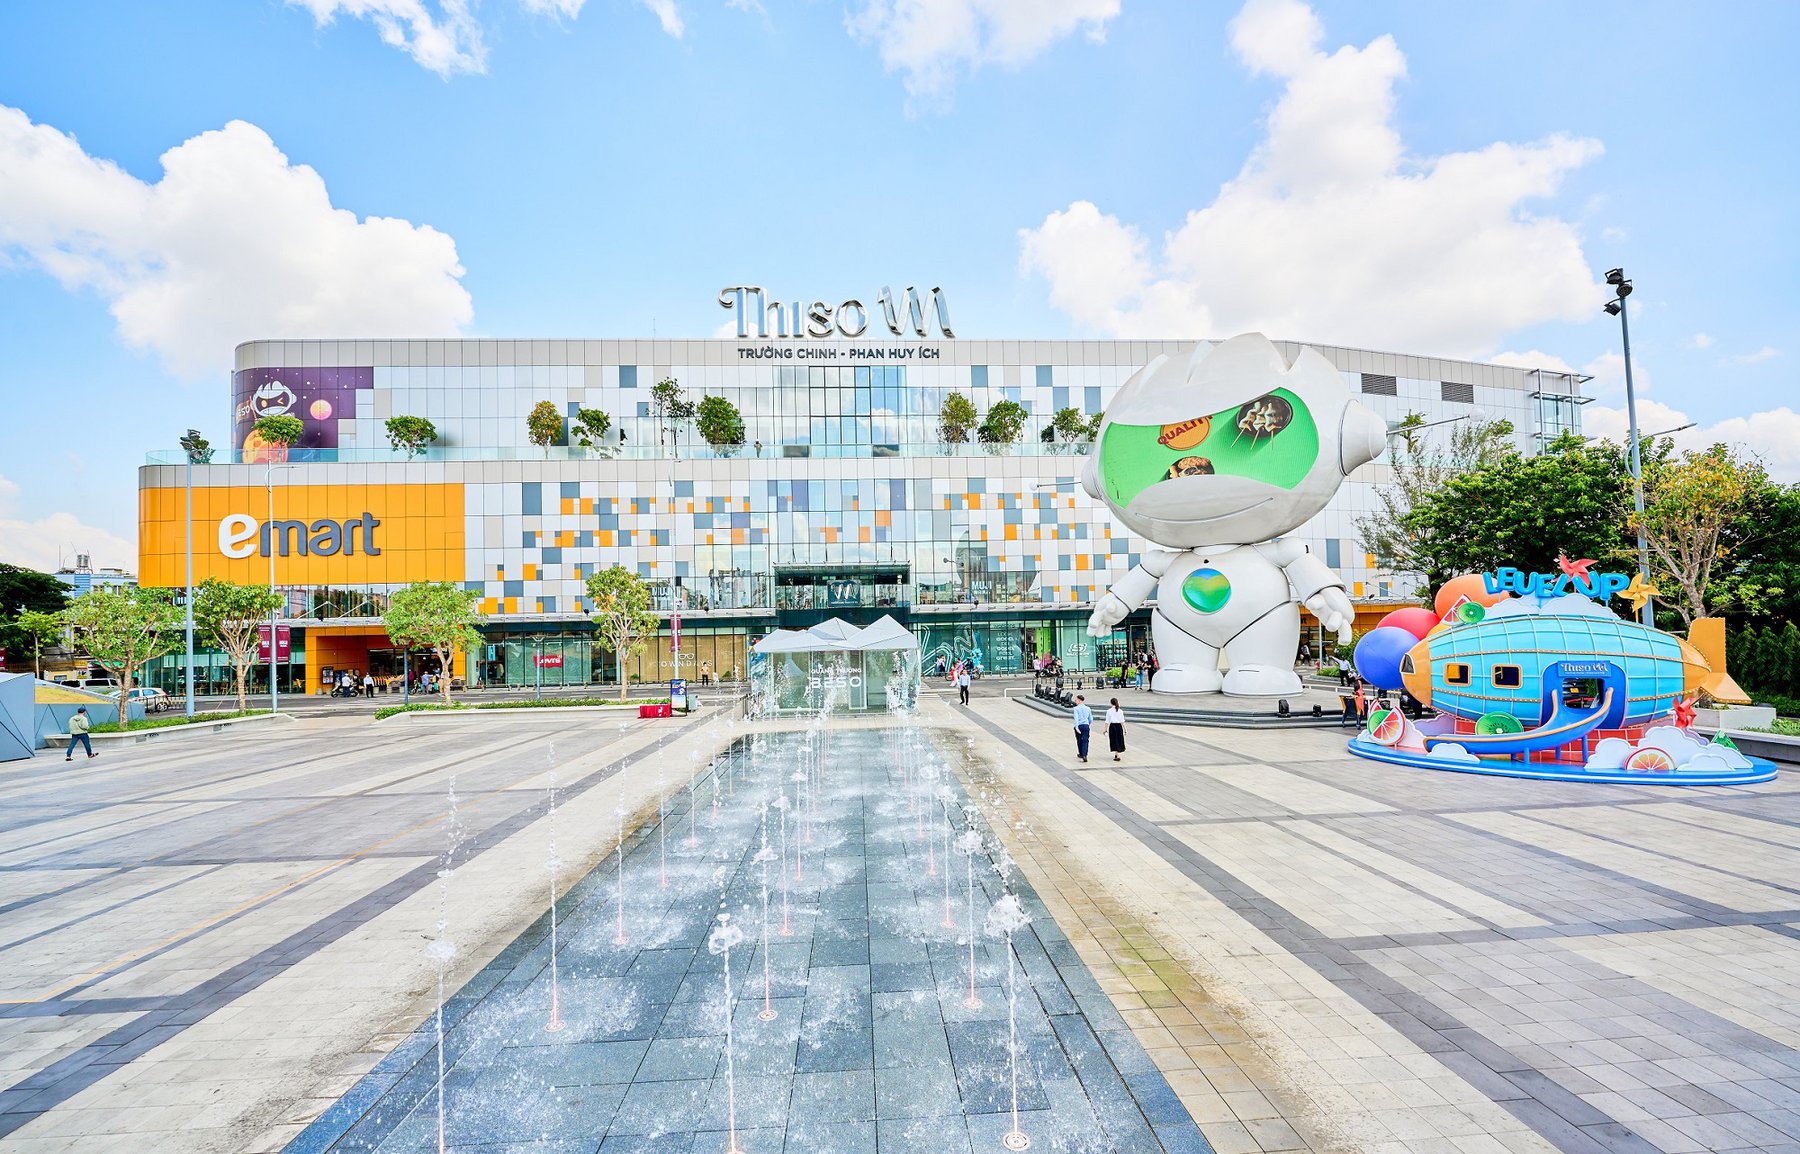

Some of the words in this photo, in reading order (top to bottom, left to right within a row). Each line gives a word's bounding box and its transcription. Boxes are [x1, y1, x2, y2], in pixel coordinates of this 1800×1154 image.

[738, 346, 792, 359] TRƯỜNG
[797, 348, 837, 359] CHINH
[849, 348, 884, 359] PHAN
[889, 348, 914, 359] HUY
[919, 346, 940, 359] ÍCH
[218, 512, 381, 559] emart
[971, 581, 992, 590] MUJI
[1572, 571, 1630, 600] UP
[811, 676, 862, 689] BESO
